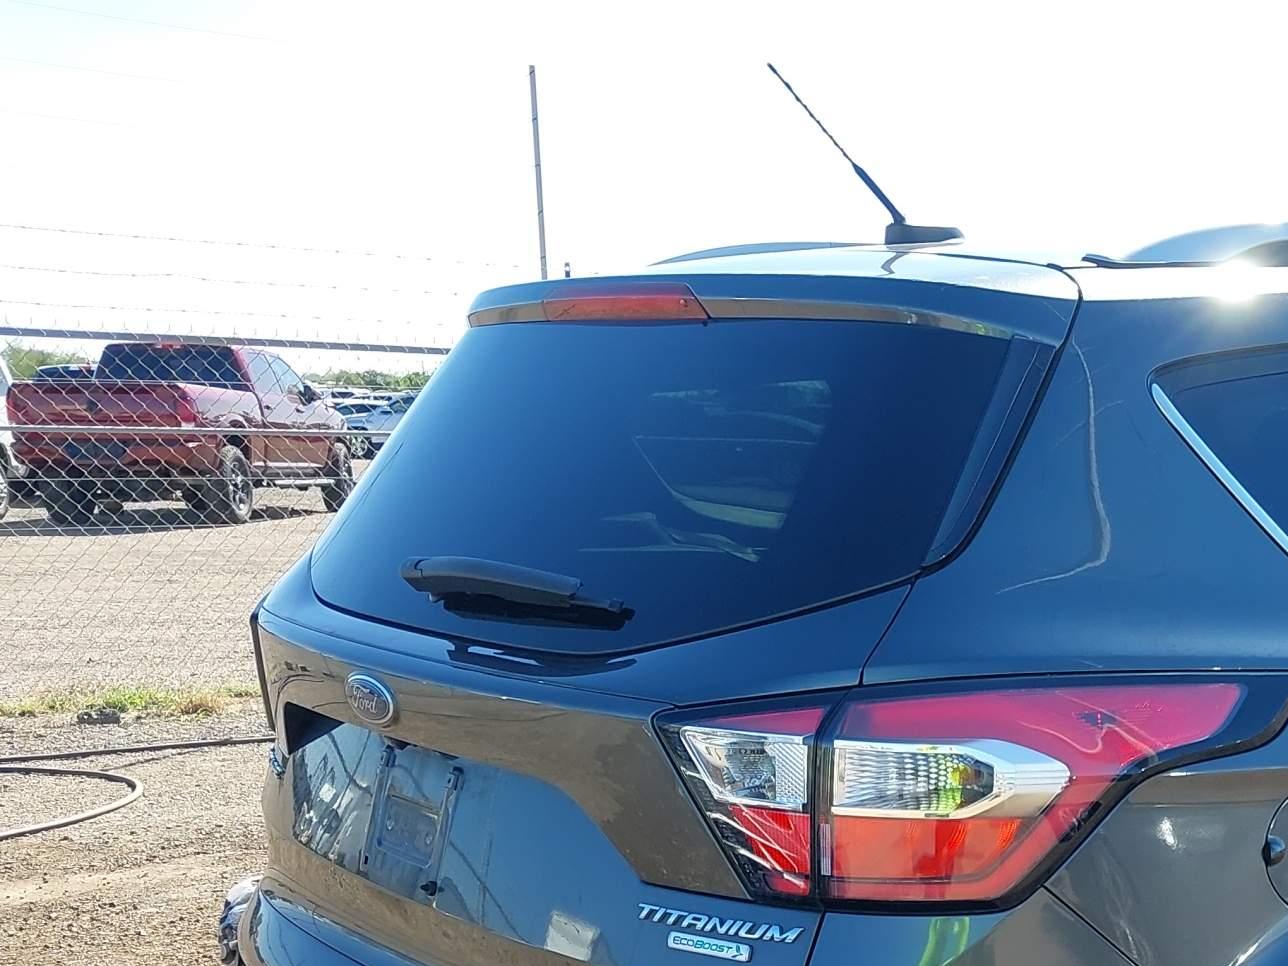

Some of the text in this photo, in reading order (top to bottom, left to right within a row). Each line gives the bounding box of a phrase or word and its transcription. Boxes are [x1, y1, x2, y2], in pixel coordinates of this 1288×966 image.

[350, 683, 378, 714] Ford
[638, 902, 804, 944] TITANIUM
[672, 935, 733, 954] ECOBOOST
